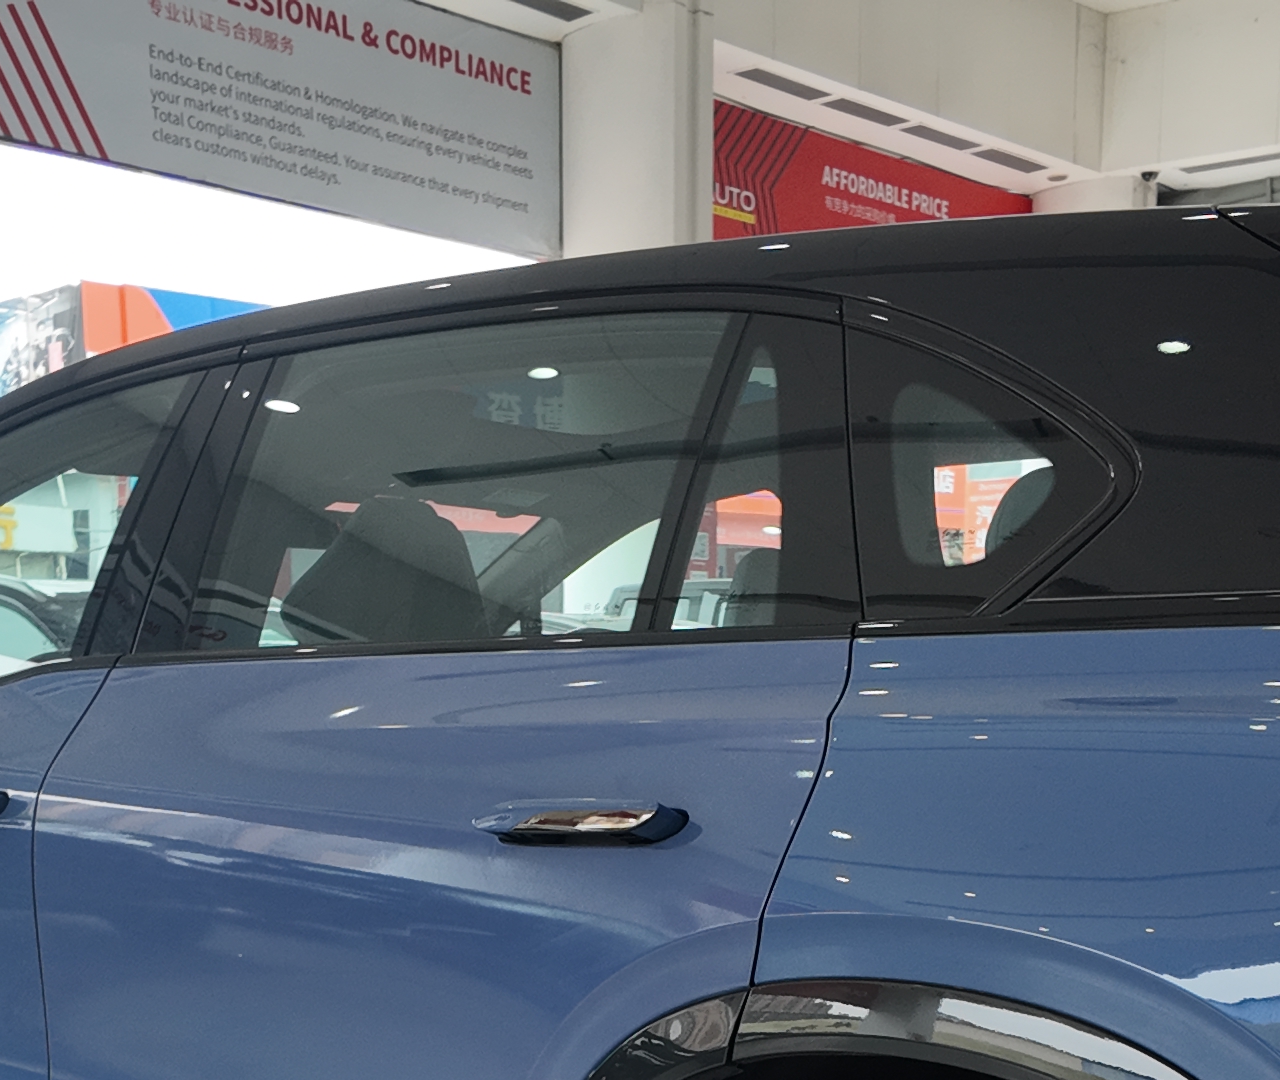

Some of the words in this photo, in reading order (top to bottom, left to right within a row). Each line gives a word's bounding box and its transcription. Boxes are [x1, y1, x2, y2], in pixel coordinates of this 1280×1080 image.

[149, 0, 295, 56] 专业认证与合规服务
[226, 0, 355, 42] SIONAL
[361, 21, 379, 49] &
[385, 29, 532, 96] COMPLIANCE
[149, 43, 223, 77] End-to-End
[225, 65, 301, 98] Certification
[303, 87, 313, 101] &
[315, 89, 399, 126] Homologation.
[401, 113, 418, 130] We
[421, 121, 466, 145] navigate
[467, 132, 484, 148] the
[486, 139, 528, 161] complex
[149, 64, 217, 95] landscape
[220, 84, 234, 99] of
[235, 88, 314, 121] international
[316, 109, 384, 142] regulations,
[385, 129, 433, 156] ensuring
[435, 144, 464, 164] every
[465, 152, 501, 172] vehicle
[503, 162, 534, 180] meets
[150, 88, 180, 104] your
[184, 96, 239, 121] market's
[242, 110, 306, 138] standards.
[152, 128, 192, 149] clears
[194, 140, 248, 163] customs
[250, 150, 298, 175] without
[300, 162, 341, 186] delays.
[152, 106, 184, 128] Total
[187, 114, 267, 150] Compliance,
[269, 135, 342, 167] Guaranteed.
[343, 153, 368, 173] Your
[371, 163, 426, 189] assurance
[428, 177, 450, 195] that
[452, 184, 480, 205] every
[481, 190, 529, 214] shipment
[712, 181, 757, 212] UTO
[821, 164, 909, 211] AFFORDABLE
[911, 191, 950, 220] PRICE
